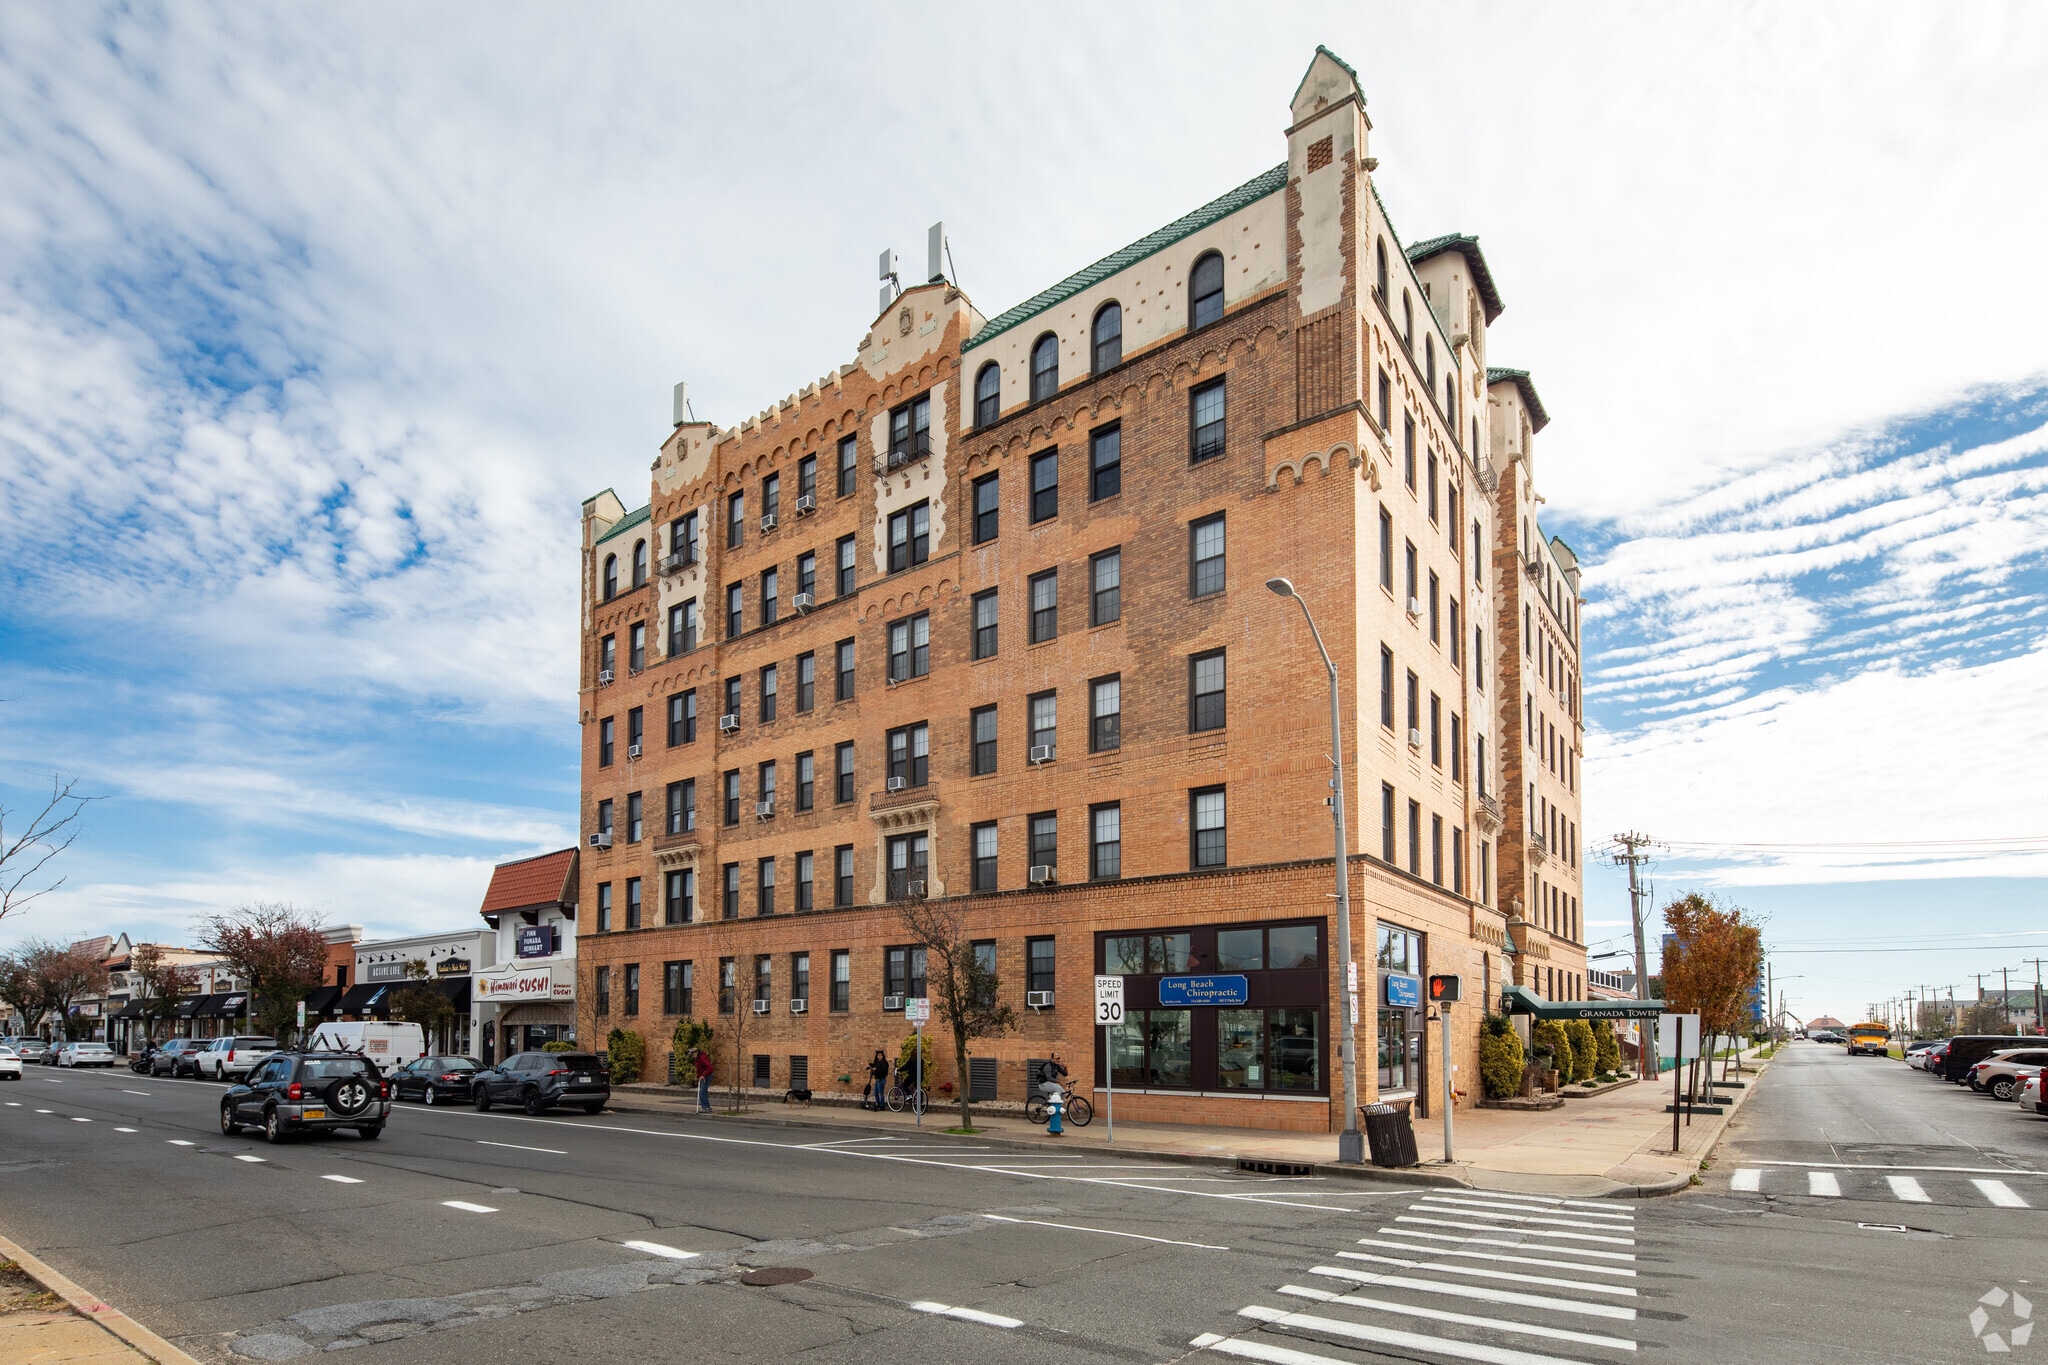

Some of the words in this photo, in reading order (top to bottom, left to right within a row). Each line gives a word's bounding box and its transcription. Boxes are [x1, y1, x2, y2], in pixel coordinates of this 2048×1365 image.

[372, 967, 388, 976] ACTIVE
[390, 966, 400, 976] LIFE
[490, 979, 518, 994] Himawari
[519, 976, 549, 993] SUSHI
[1097, 980, 1122, 988] SPEED
[1168, 981, 1186, 990] Long
[1190, 979, 1214, 988] Beach
[1186, 988, 1238, 998] Chiropractic
[1100, 1002, 1121, 1020] 30
